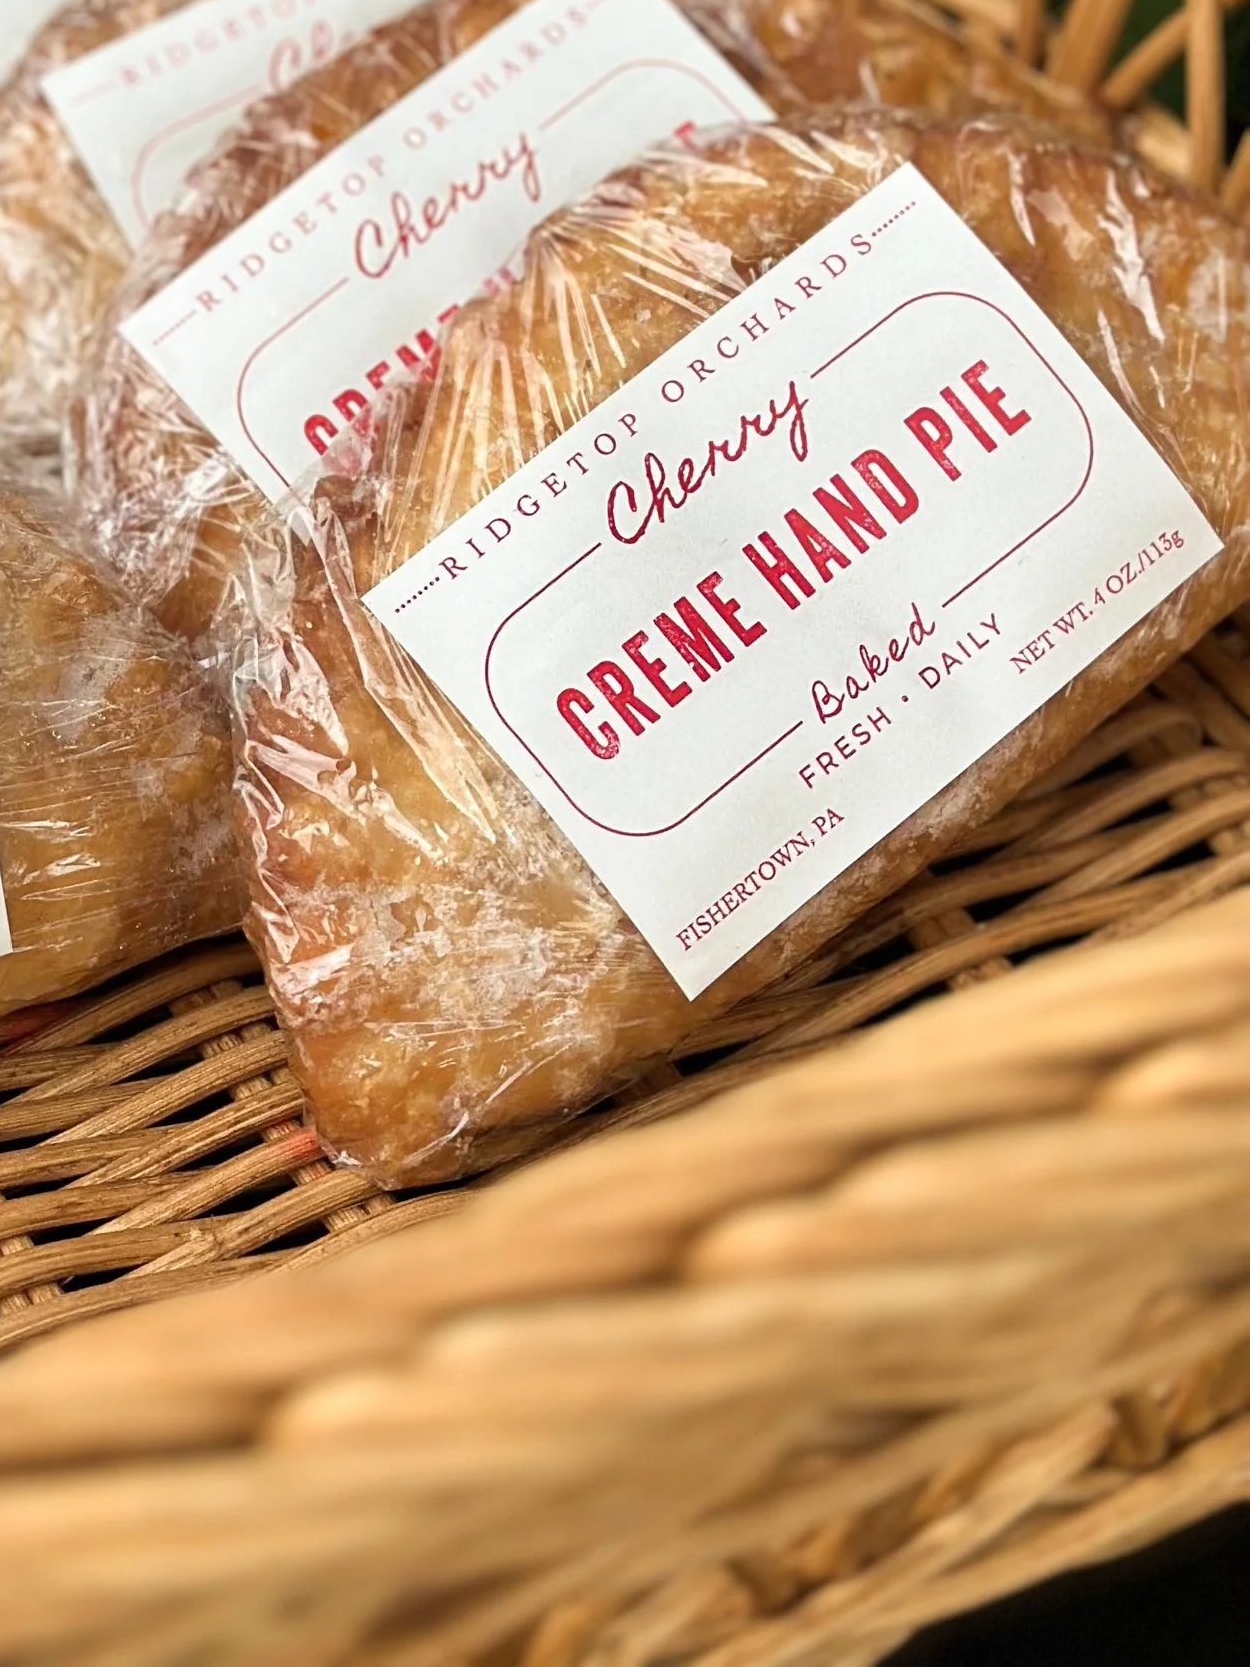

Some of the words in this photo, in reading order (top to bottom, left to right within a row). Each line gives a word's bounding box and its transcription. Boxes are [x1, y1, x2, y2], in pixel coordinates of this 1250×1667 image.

[195, 154, 387, 312] RIDGETOP
[402, 6, 587, 149] ORCHARDS
[353, 132, 540, 280] Cherry
[439, 412, 639, 580] RIDGETOP
[661, 234, 873, 404] ORCHARDS
[607, 381, 810, 545] Cherry
[556, 571, 767, 761] CREME
[741, 449, 920, 611] HAND
[903, 360, 1031, 482] PIE
[1010, 629, 1056, 674] NET
[1053, 602, 1094, 636] WT.
[1093, 587, 1106, 605] 4
[1105, 530, 1185, 595] OZ./113g
[798, 707, 893, 789] FRESH
[918, 612, 1002, 690] DAILY
[810, 602, 937, 724] Baked
[675, 830, 817, 952] FISHERTOWN,
[813, 806, 845, 838] PA
